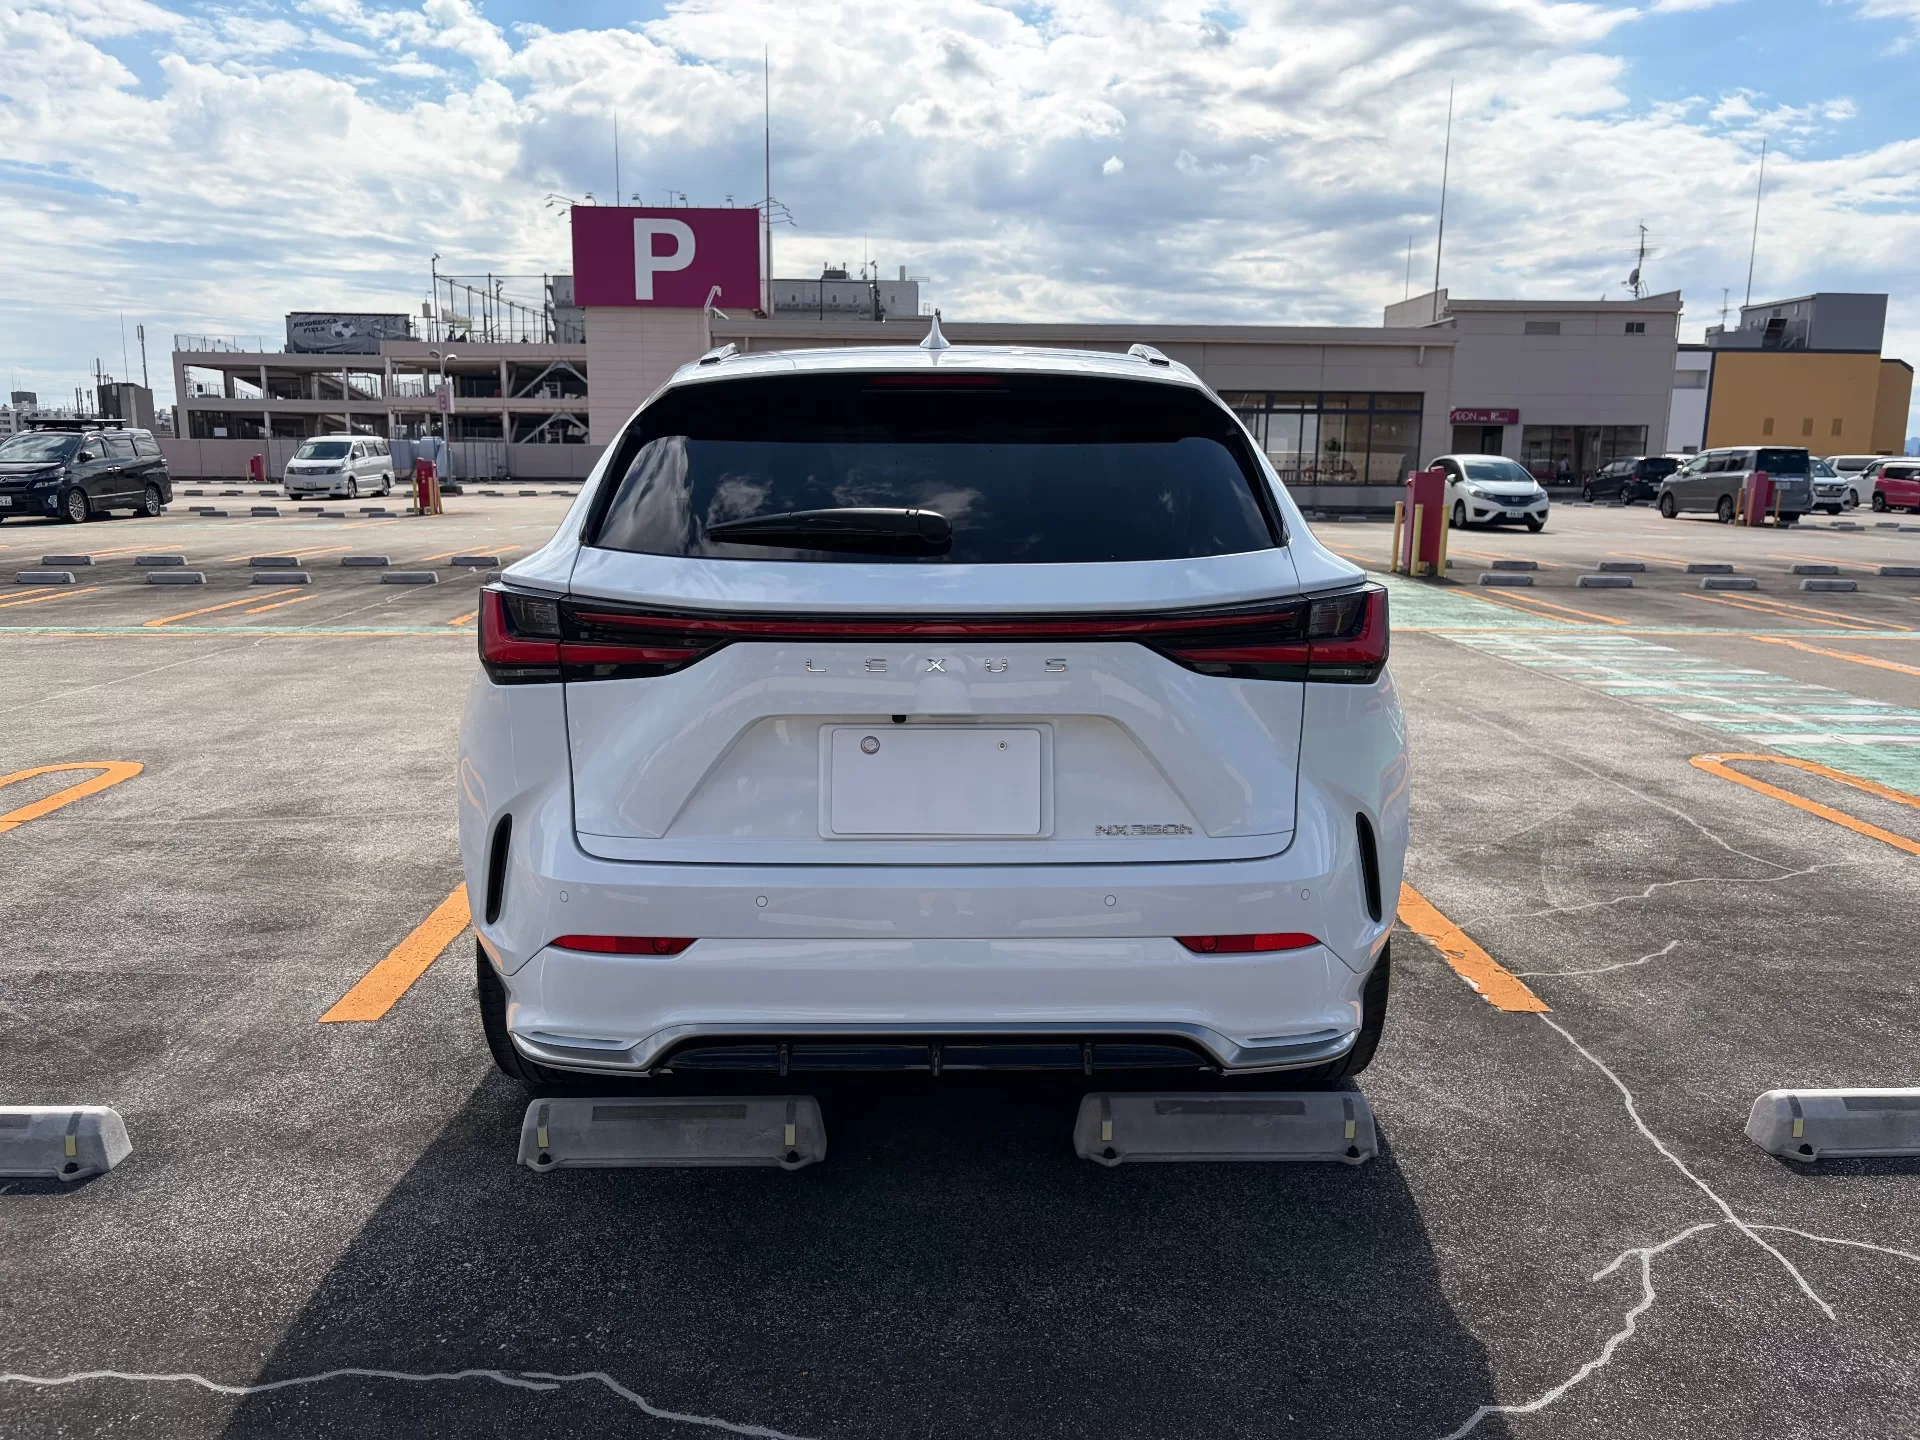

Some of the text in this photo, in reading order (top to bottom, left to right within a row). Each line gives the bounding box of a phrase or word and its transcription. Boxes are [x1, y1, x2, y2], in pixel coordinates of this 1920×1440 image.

[633, 218, 696, 300] P
[439, 394, 448, 410] B
[805, 658, 1067, 672] LEXUS
